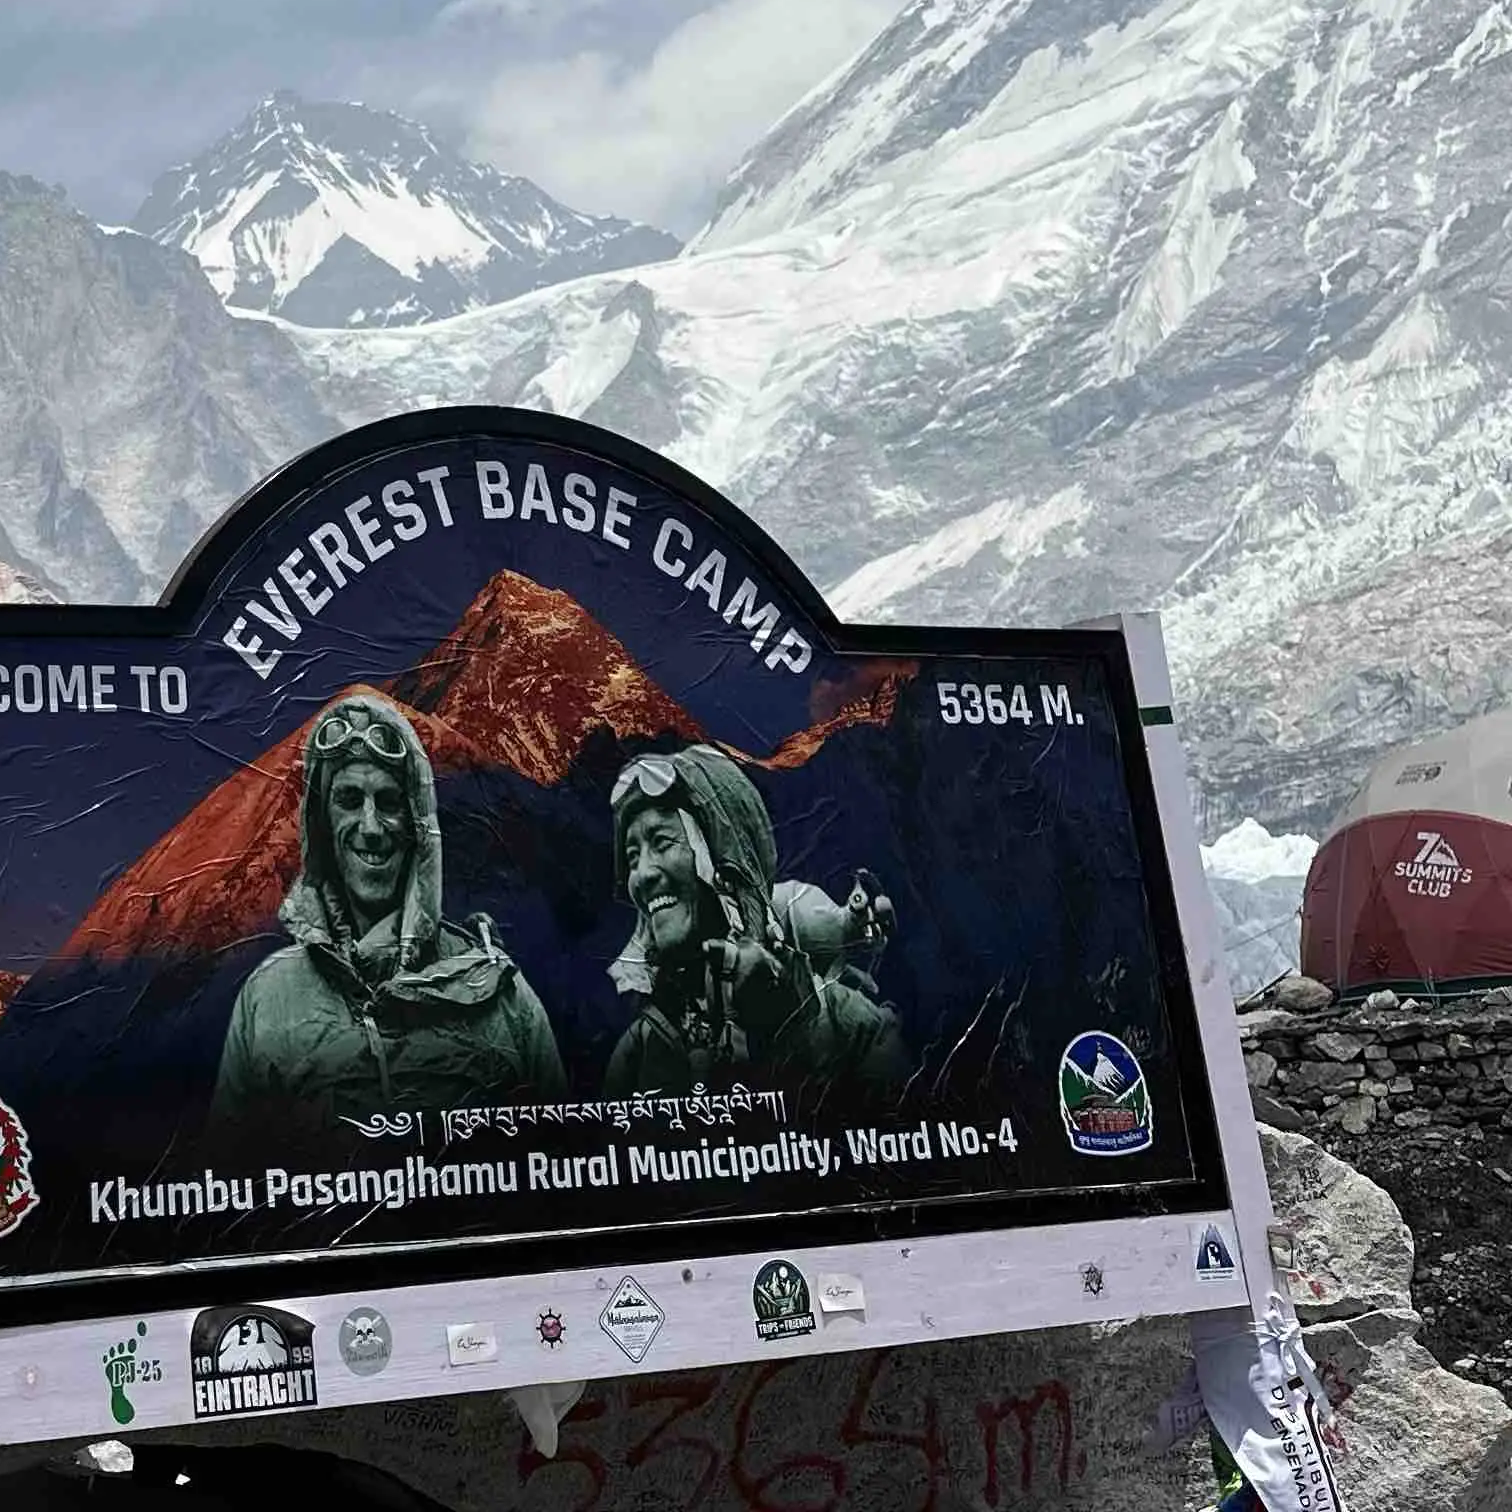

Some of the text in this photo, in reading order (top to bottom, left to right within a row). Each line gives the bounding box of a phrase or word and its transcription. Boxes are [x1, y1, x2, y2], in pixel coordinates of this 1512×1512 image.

[223, 461, 813, 680] EVEREST BASE CAMP
[130, 666, 188, 713] TO
[937, 682, 1085, 726] 5364 M.
[1414, 832, 1441, 863] 7
[1394, 862, 1473, 884] SUMMITS
[1407, 879, 1452, 898] CLUB
[90, 1169, 254, 1223] Khumbu
[265, 1156, 518, 1209] Pasanglhamu
[528, 1144, 619, 1190] Rural
[628, 1132, 841, 1183] Municipality,
[845, 1121, 932, 1166] Ward
[292, 1346, 313, 1364] 99
[195, 1369, 314, 1414] EINTRACHT
[1270, 1417, 1311, 1512] ENSENAD
